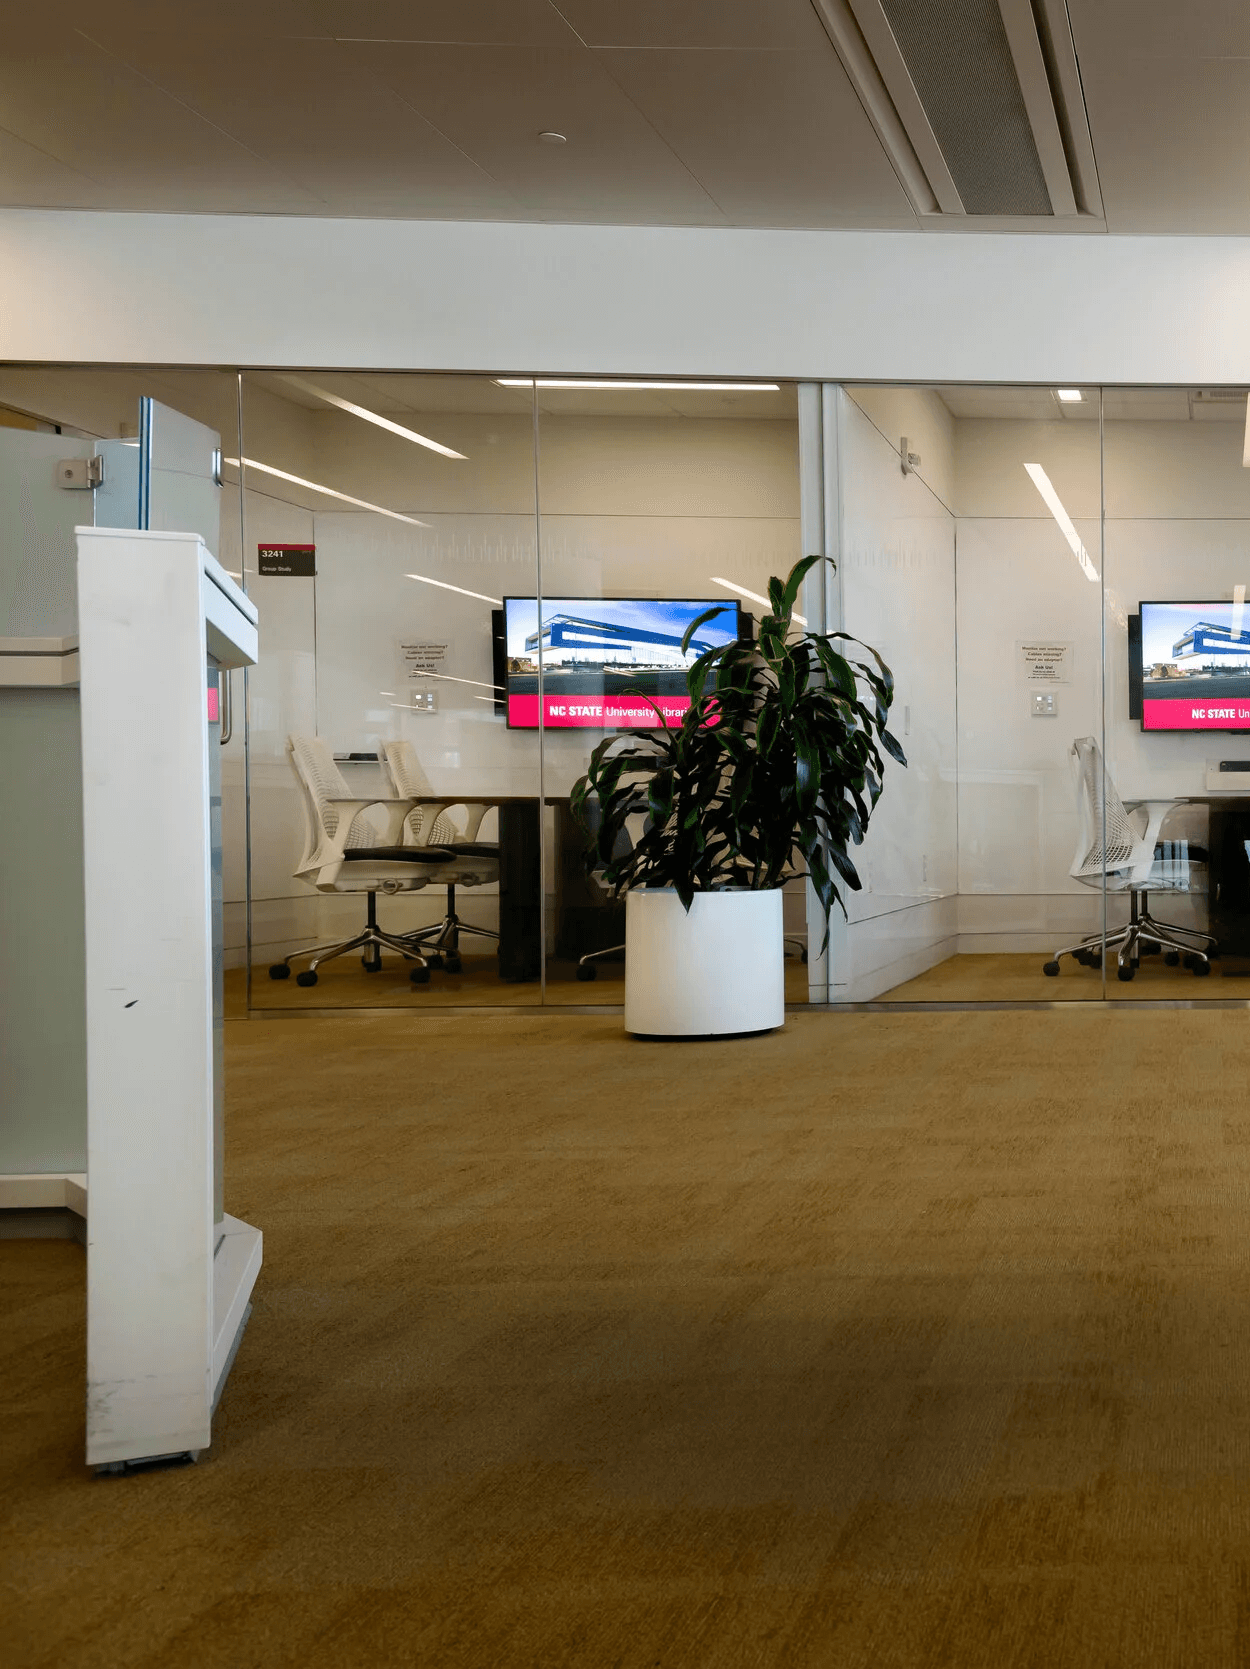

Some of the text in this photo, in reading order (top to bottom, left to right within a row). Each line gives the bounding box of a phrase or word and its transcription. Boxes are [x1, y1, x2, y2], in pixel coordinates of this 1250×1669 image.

[261, 550, 283, 558] 3241
[549, 705, 566, 716] NC
[568, 705, 603, 717] STATE
[605, 705, 655, 718] University
[1191, 708, 1206, 719] NC
[1207, 708, 1236, 719] STATE
